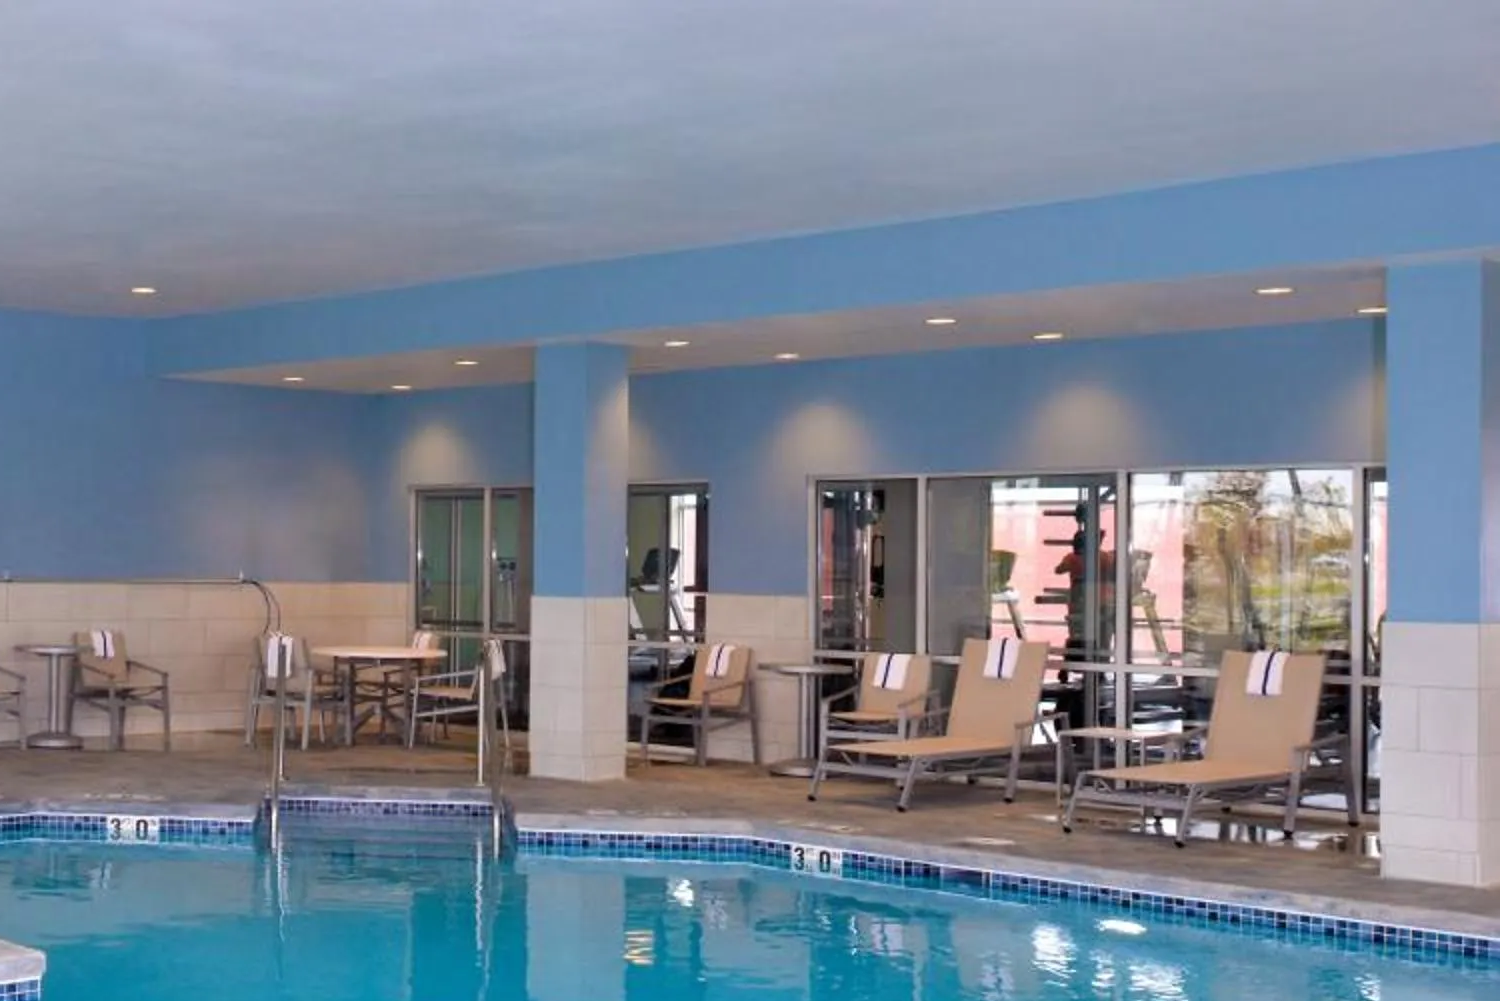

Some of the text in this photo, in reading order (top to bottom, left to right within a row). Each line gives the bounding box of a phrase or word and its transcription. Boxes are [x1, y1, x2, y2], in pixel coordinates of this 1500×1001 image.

[110, 817, 149, 840] 3 0
[794, 846, 831, 872] 3 0
